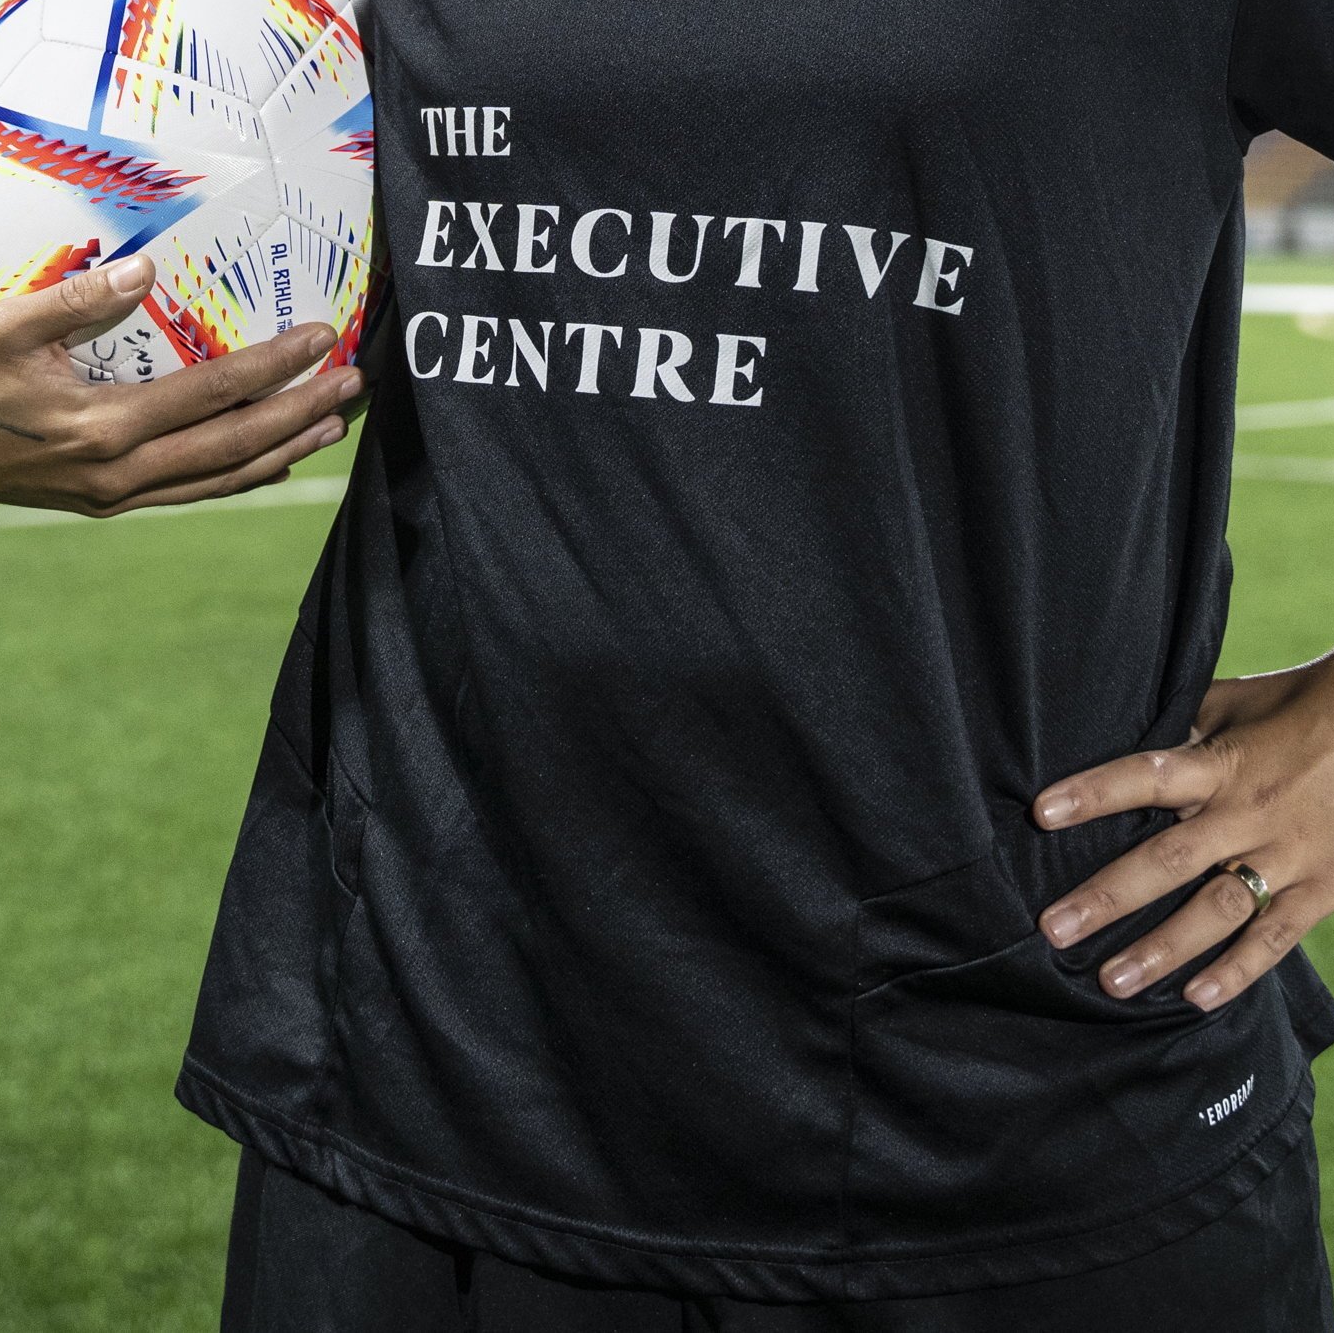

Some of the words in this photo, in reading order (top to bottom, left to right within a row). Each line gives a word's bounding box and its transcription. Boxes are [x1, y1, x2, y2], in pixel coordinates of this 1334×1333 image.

[420, 106, 511, 157] THE
[270, 242, 288, 266] AL
[414, 200, 974, 316] EXECUTIVE
[273, 268, 293, 317] RIHLA
[405, 311, 767, 408] CENTRE
